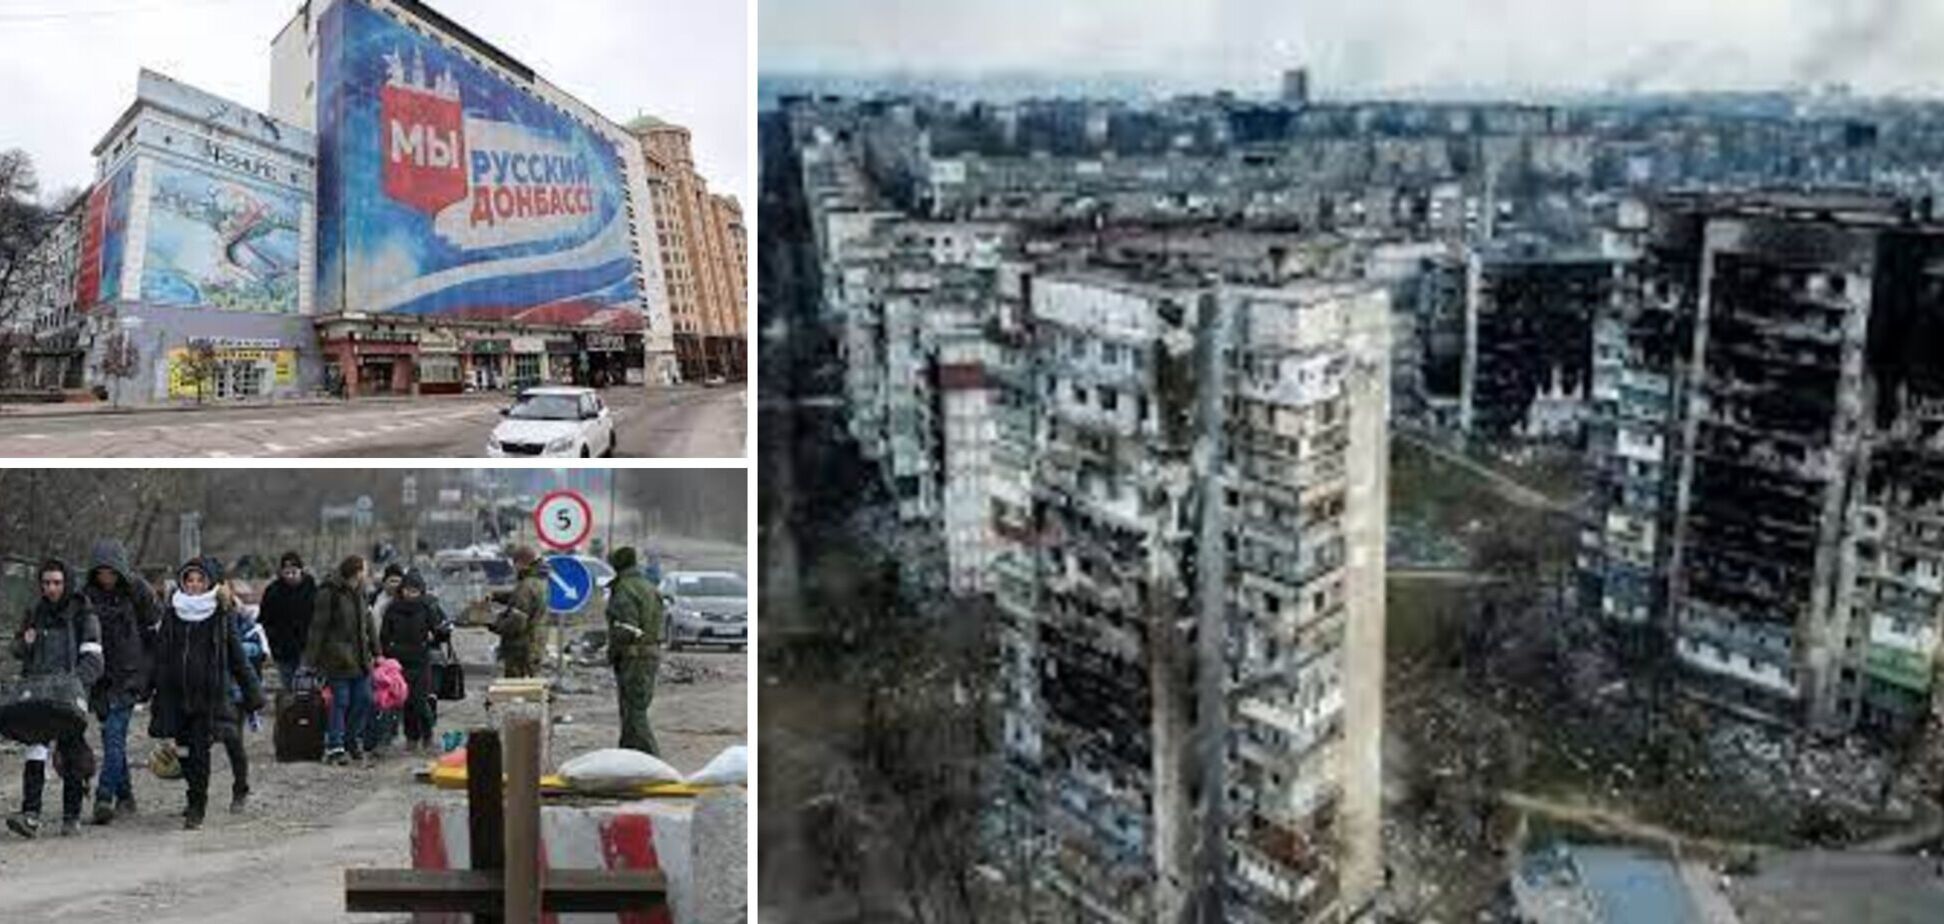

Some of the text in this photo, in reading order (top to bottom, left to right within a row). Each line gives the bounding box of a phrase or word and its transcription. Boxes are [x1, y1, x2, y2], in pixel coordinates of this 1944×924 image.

[391, 119, 459, 169] МЫ
[471, 149, 589, 185] РУССКИЙ
[556, 508, 571, 530] 5
